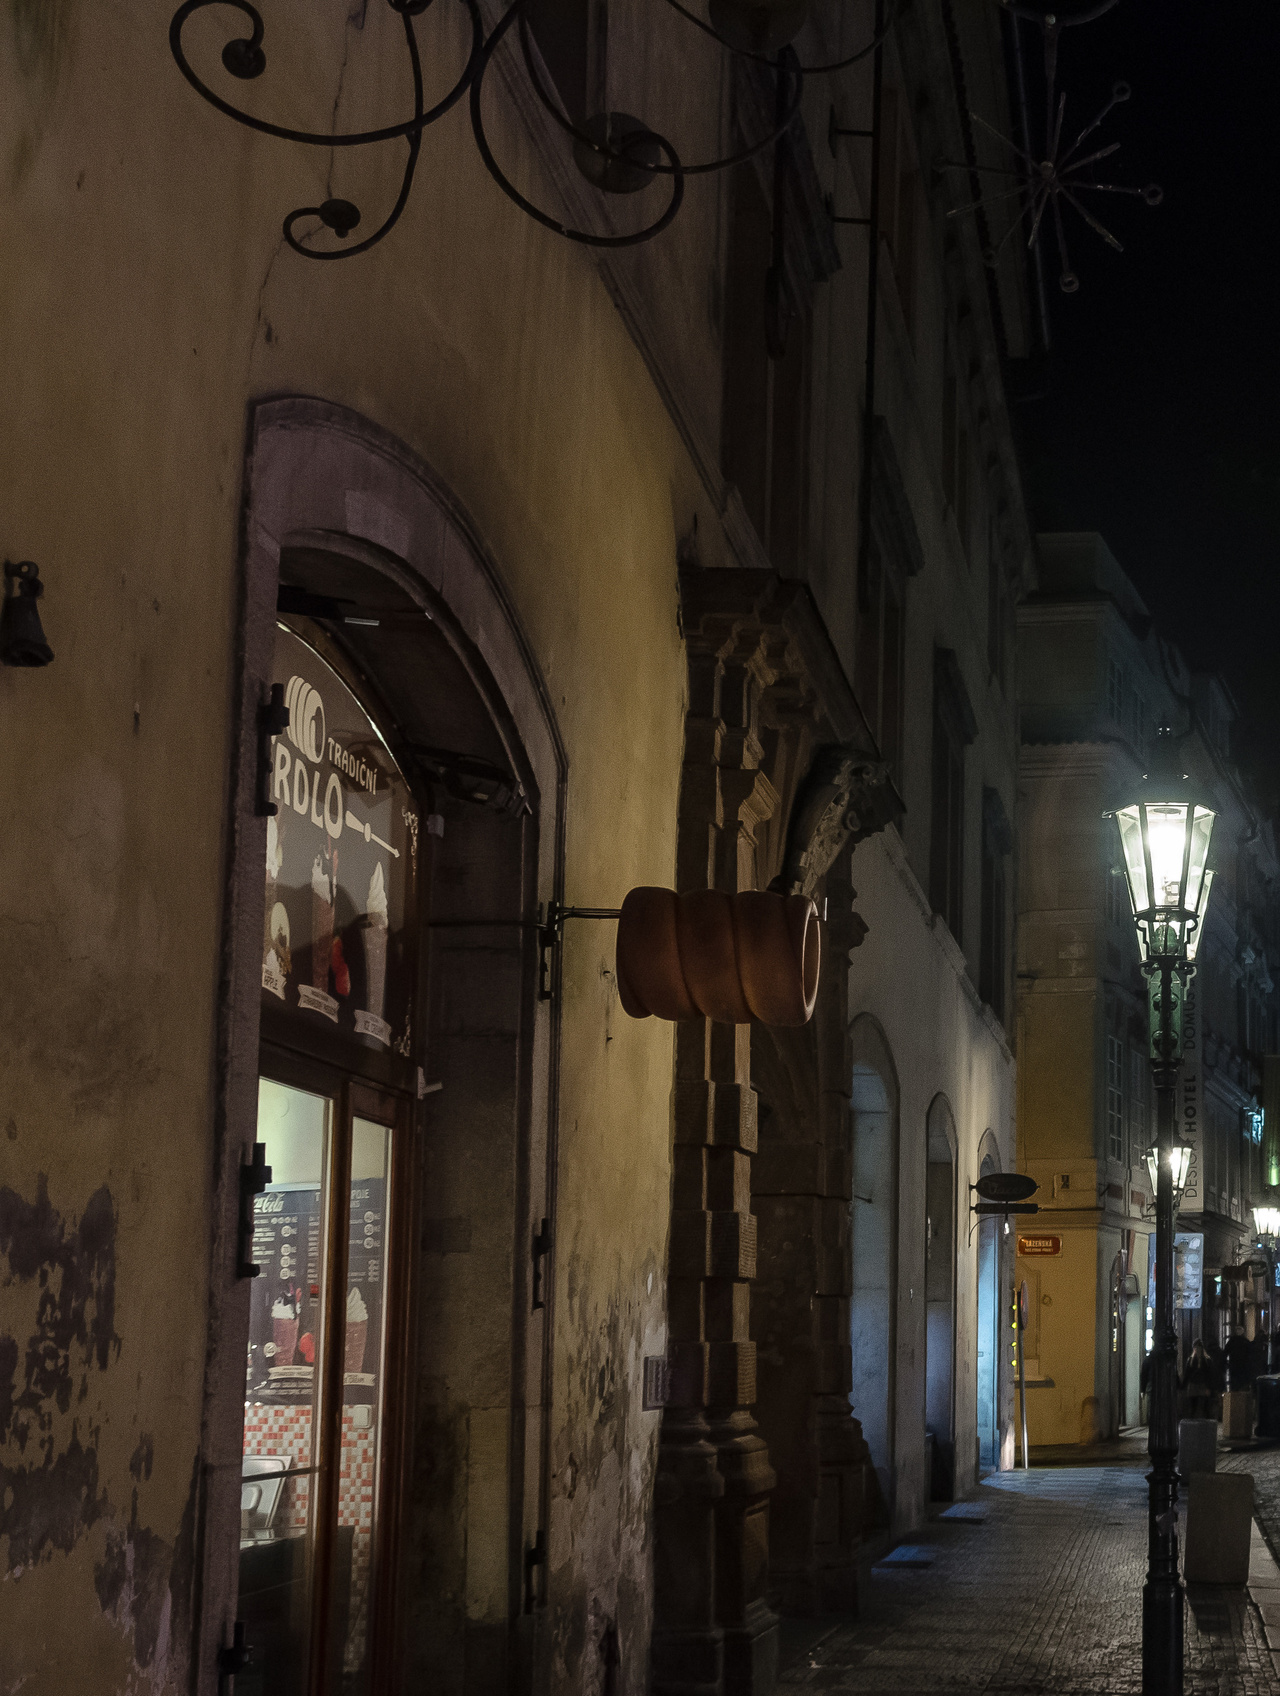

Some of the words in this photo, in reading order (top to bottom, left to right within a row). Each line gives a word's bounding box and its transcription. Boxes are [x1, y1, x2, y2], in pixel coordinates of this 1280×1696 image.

[271, 736, 343, 839] RDLO
[328, 737, 377, 795] TRADIČNÍ
[1184, 1075, 1197, 1132] HOTEL
